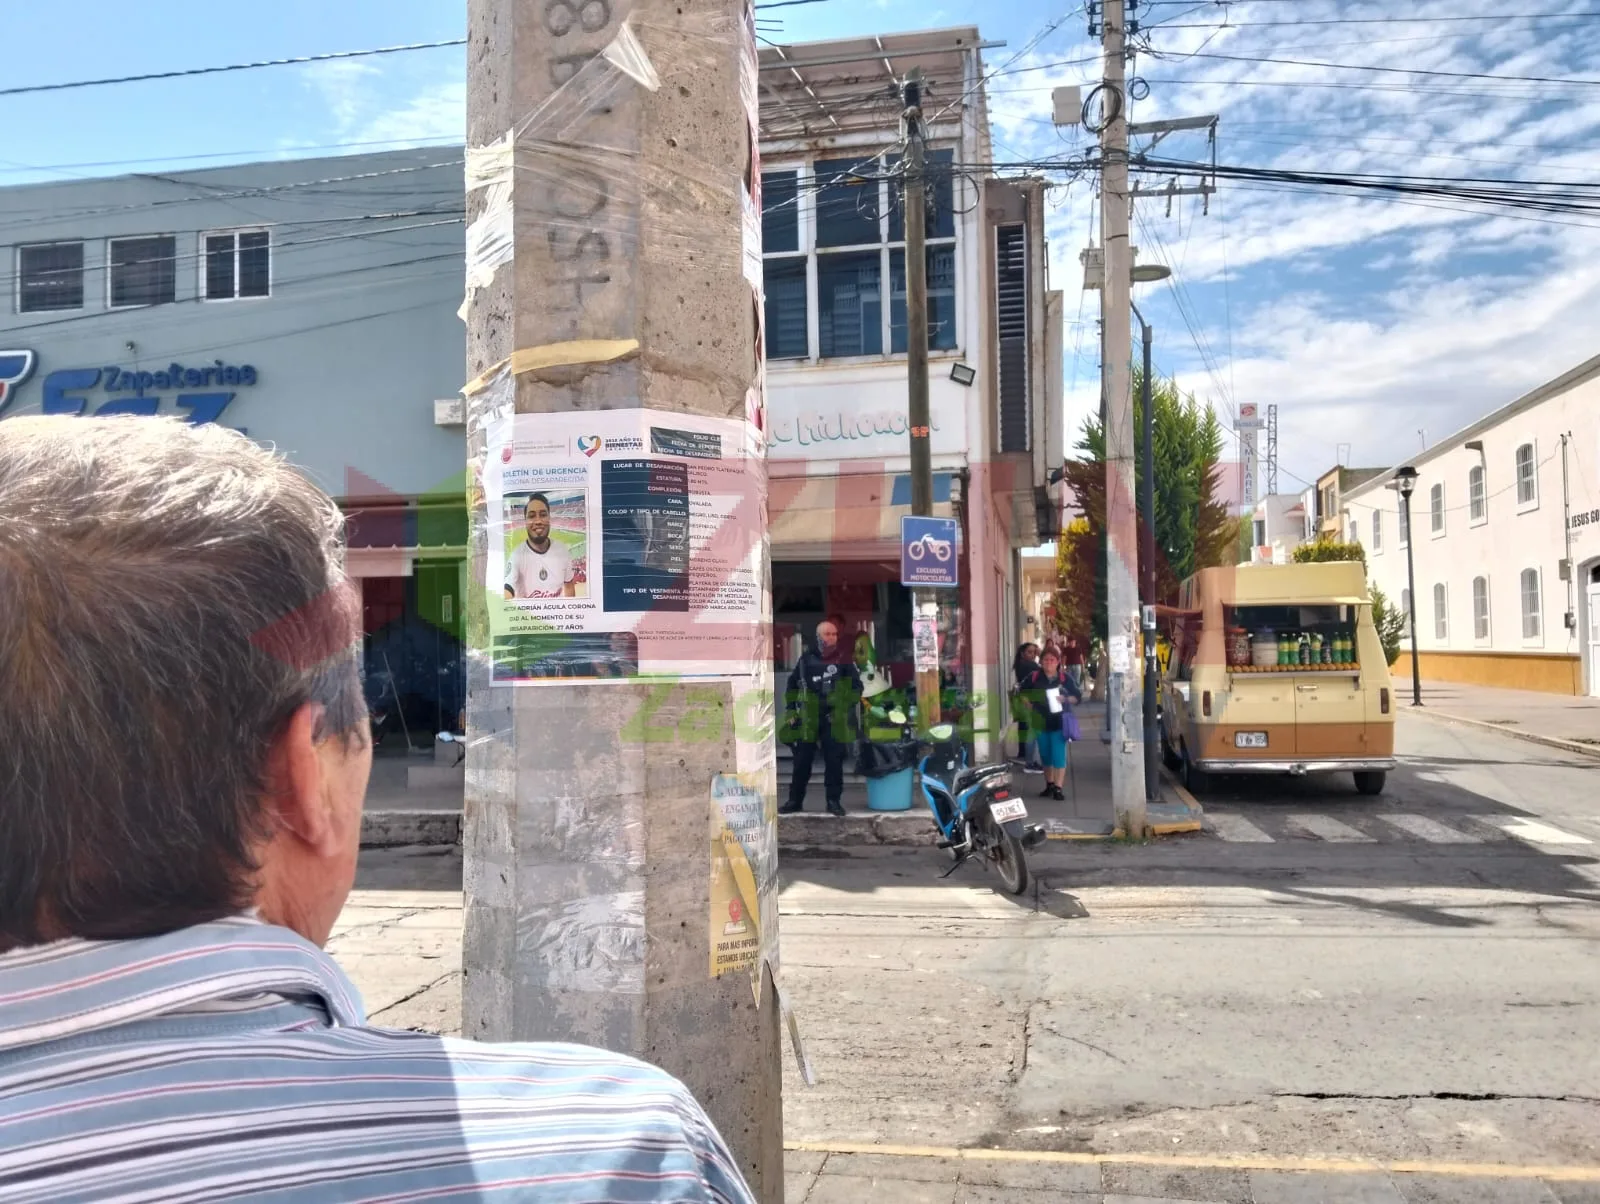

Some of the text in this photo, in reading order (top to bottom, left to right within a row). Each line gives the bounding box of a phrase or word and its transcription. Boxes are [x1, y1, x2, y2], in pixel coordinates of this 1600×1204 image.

[546, 467, 587, 475] URGENCIA
[531, 476, 586, 484] DESAPARECIDA
[1571, 511, 1590, 529] JESUS
[910, 574, 953, 582] MOTOCICLETAS
[724, 834, 743, 845] PAGO
[717, 942, 730, 951] PARA
[730, 940, 740, 950] MAS
[717, 953, 739, 965] ESTAMOS
